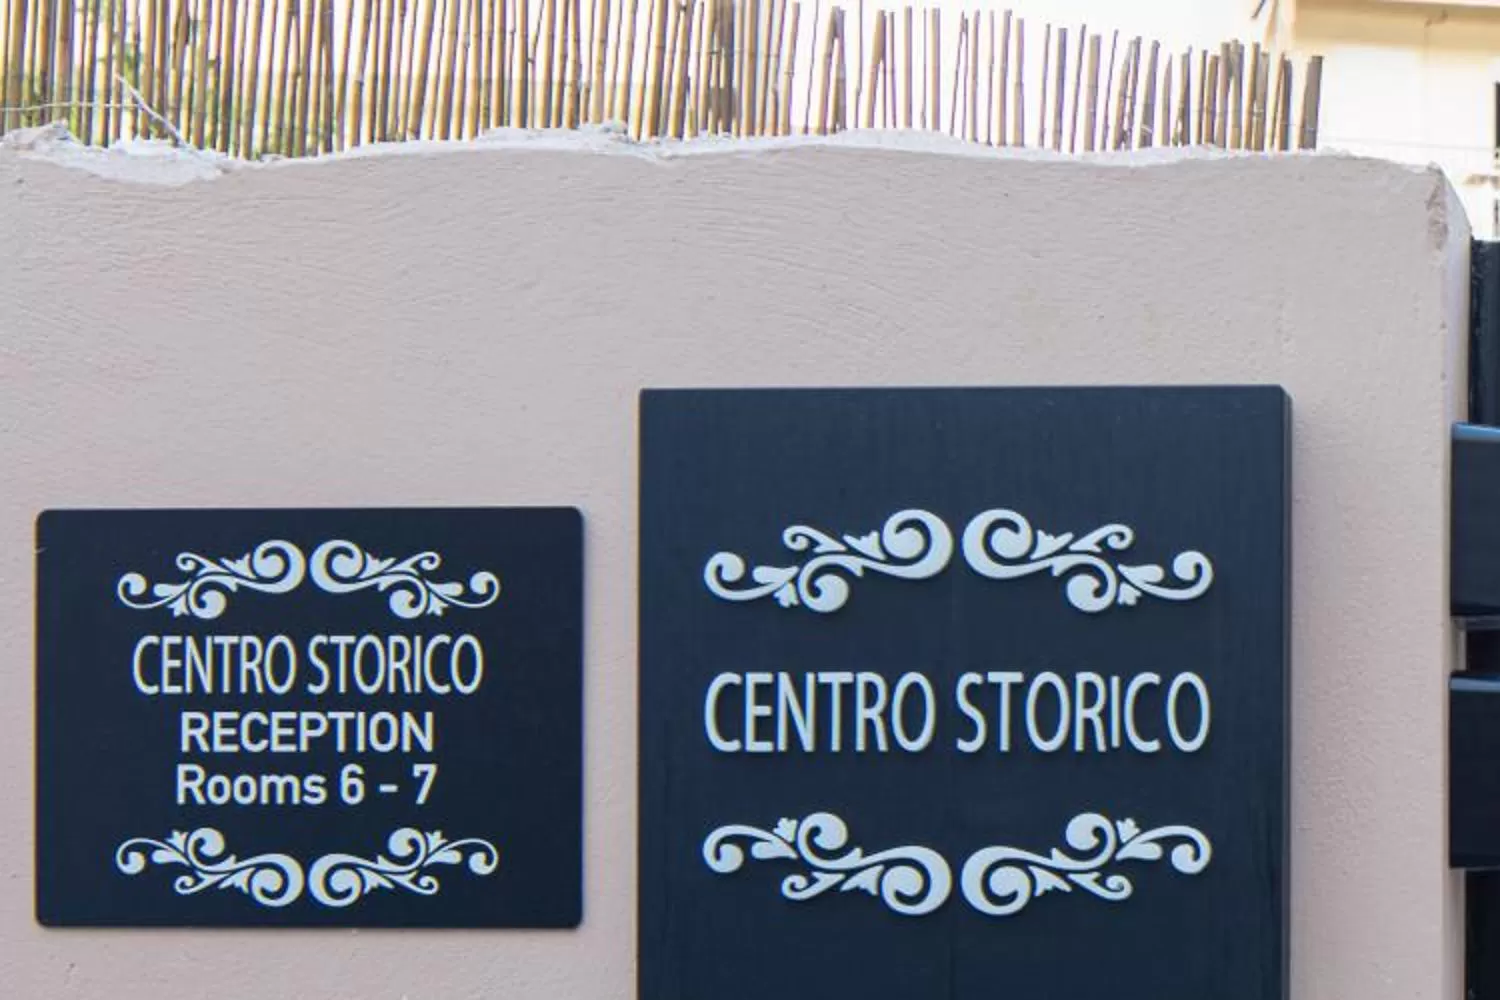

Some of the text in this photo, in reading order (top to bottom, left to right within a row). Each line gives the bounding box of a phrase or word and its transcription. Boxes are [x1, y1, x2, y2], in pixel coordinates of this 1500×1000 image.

[132, 634, 484, 695] CENTRO STORICO
[180, 710, 434, 754] RECEPTION
[705, 670, 1211, 753] CENTRO STORICO
[176, 763, 327, 805] Rooms
[340, 763, 366, 805] 6
[412, 763, 438, 805] 7
